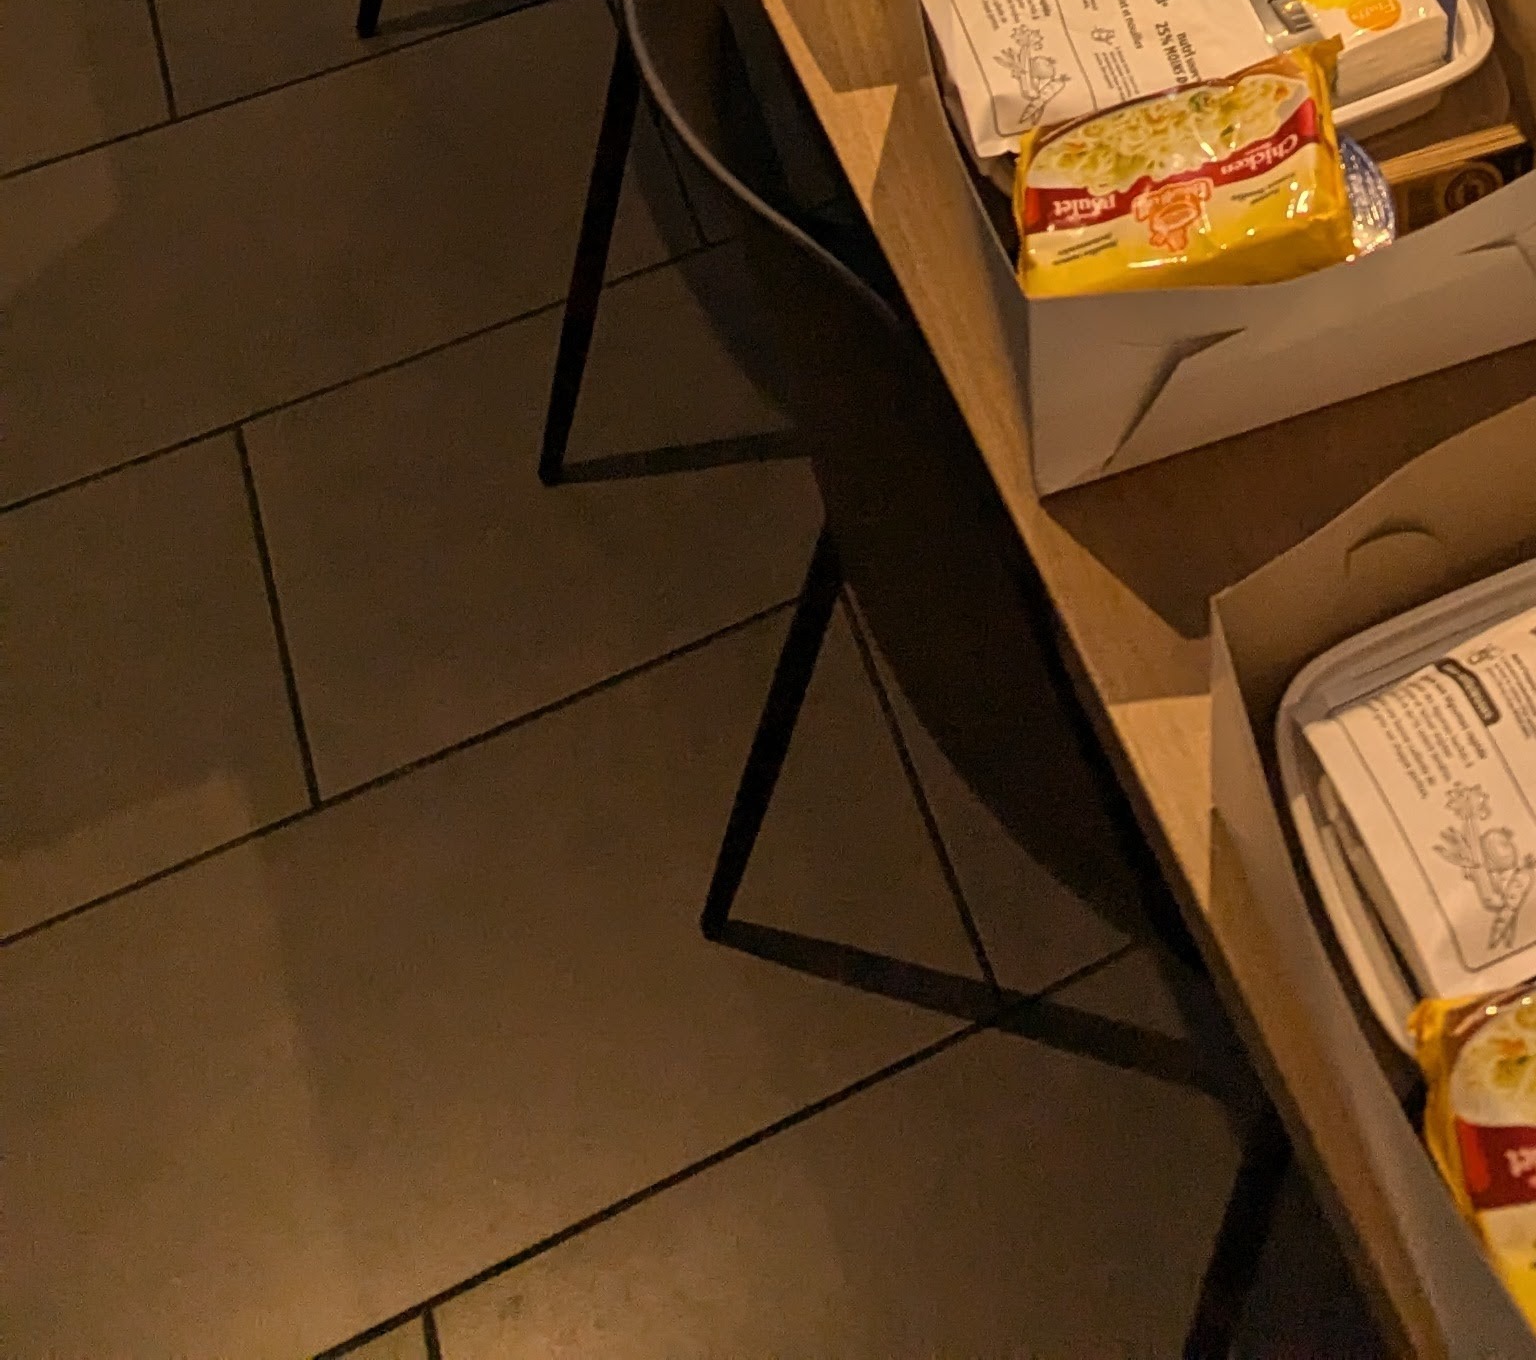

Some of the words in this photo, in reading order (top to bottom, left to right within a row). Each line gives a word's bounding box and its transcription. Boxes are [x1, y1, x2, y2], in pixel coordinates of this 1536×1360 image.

[1155, 21, 1174, 47] 25%
[1162, 45, 1187, 76] MOINS
[1220, 133, 1299, 176] Chicken
